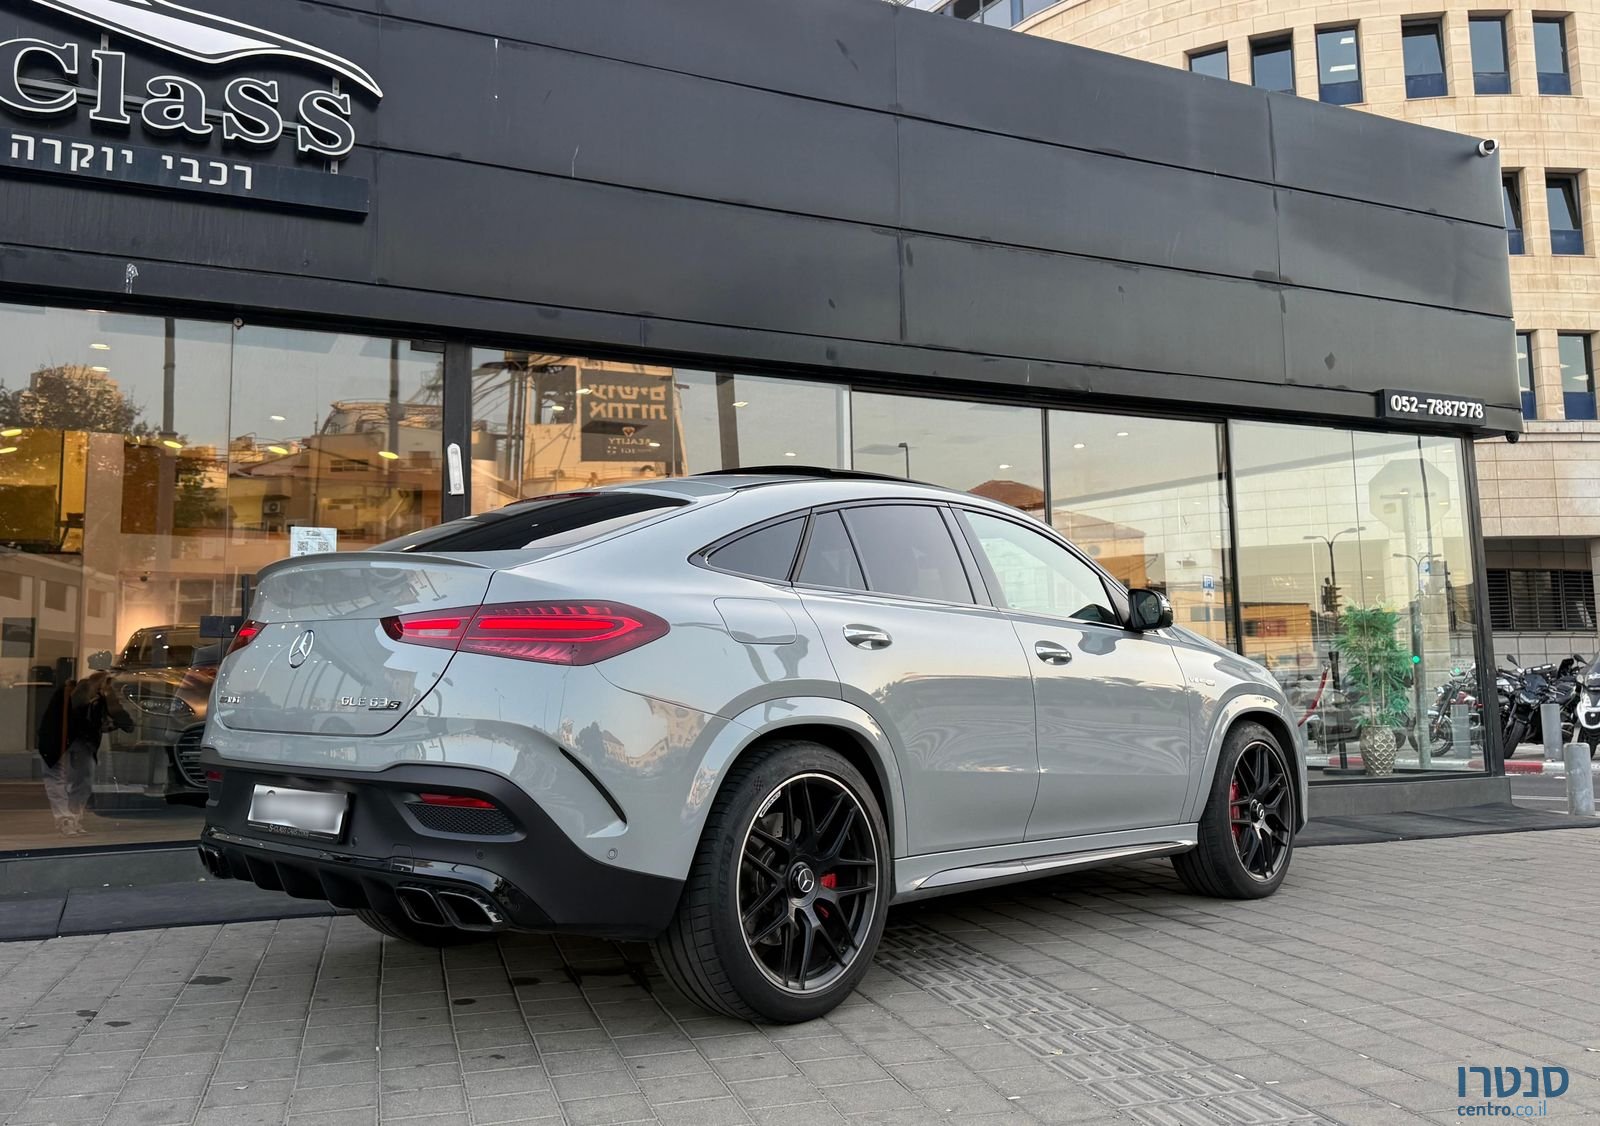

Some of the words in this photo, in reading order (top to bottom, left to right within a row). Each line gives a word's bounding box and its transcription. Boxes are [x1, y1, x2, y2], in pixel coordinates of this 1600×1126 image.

[0, 38, 356, 156] Class
[10, 133, 134, 172] יוקרה
[161, 154, 253, 191] רכבי
[1390, 394, 1484, 419] 052-7887978
[341, 696, 367, 707] GLE
